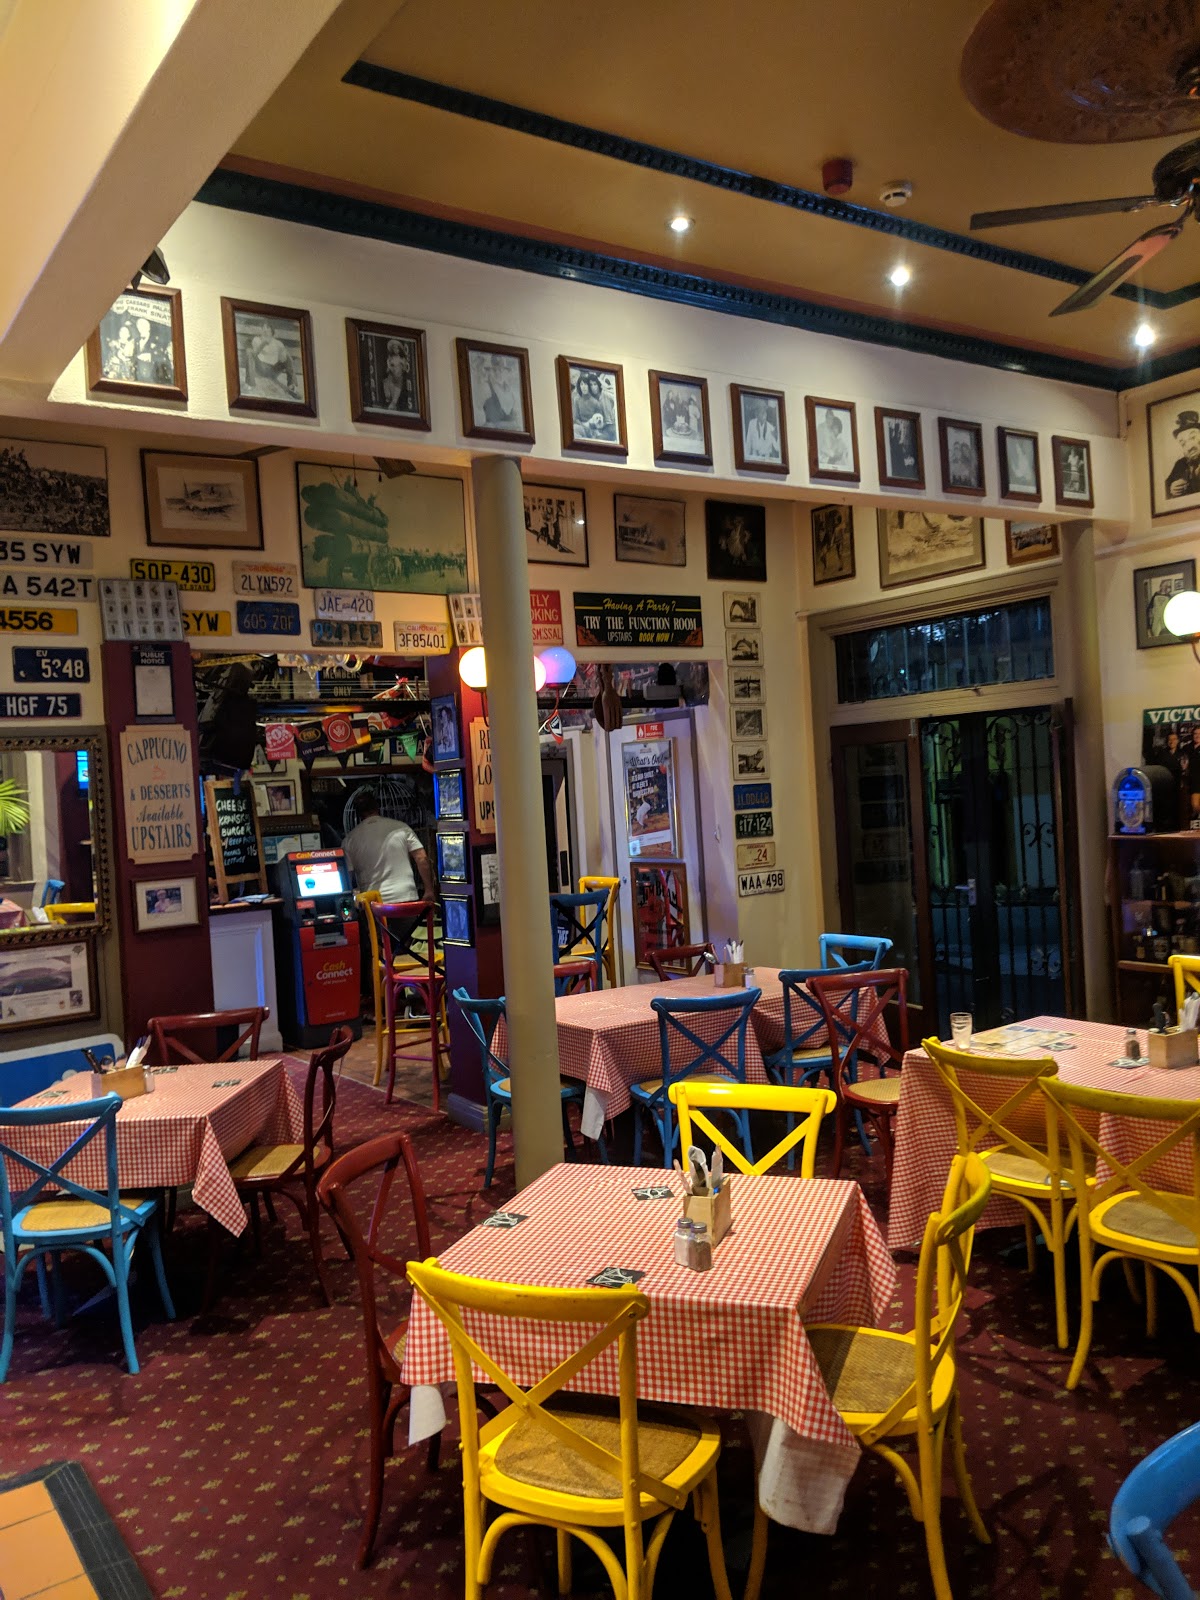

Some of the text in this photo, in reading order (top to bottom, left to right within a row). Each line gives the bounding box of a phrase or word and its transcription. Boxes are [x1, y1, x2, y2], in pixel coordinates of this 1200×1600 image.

[153, 305, 170, 313] PALA
[33, 543, 80, 564] SYW
[27, 576, 92, 597] 542T
[241, 574, 293, 593] 2LYN592
[351, 598, 374, 613] 420
[530, 594, 549, 607] TLY
[603, 598, 633, 615] Having
[636, 599, 643, 611] A
[583, 616, 696, 631] TRY THE FUNCTION ROOM
[607, 631, 633, 642] UPSTAIRS
[639, 632, 655, 642] BOOK
[6, 696, 68, 716] HGF 75
[127, 737, 187, 765] CAPPUCINO
[140, 783, 191, 801] DESSERTS
[136, 804, 184, 823] Available
[216, 799, 247, 812] CHEESE
[131, 823, 192, 851] UPSTAIRS
[221, 822, 252, 836] BURGER
[741, 875, 762, 890] WAA
[766, 873, 783, 887] 498
[316, 967, 353, 980] Connect
[322, 960, 346, 971] Cash
